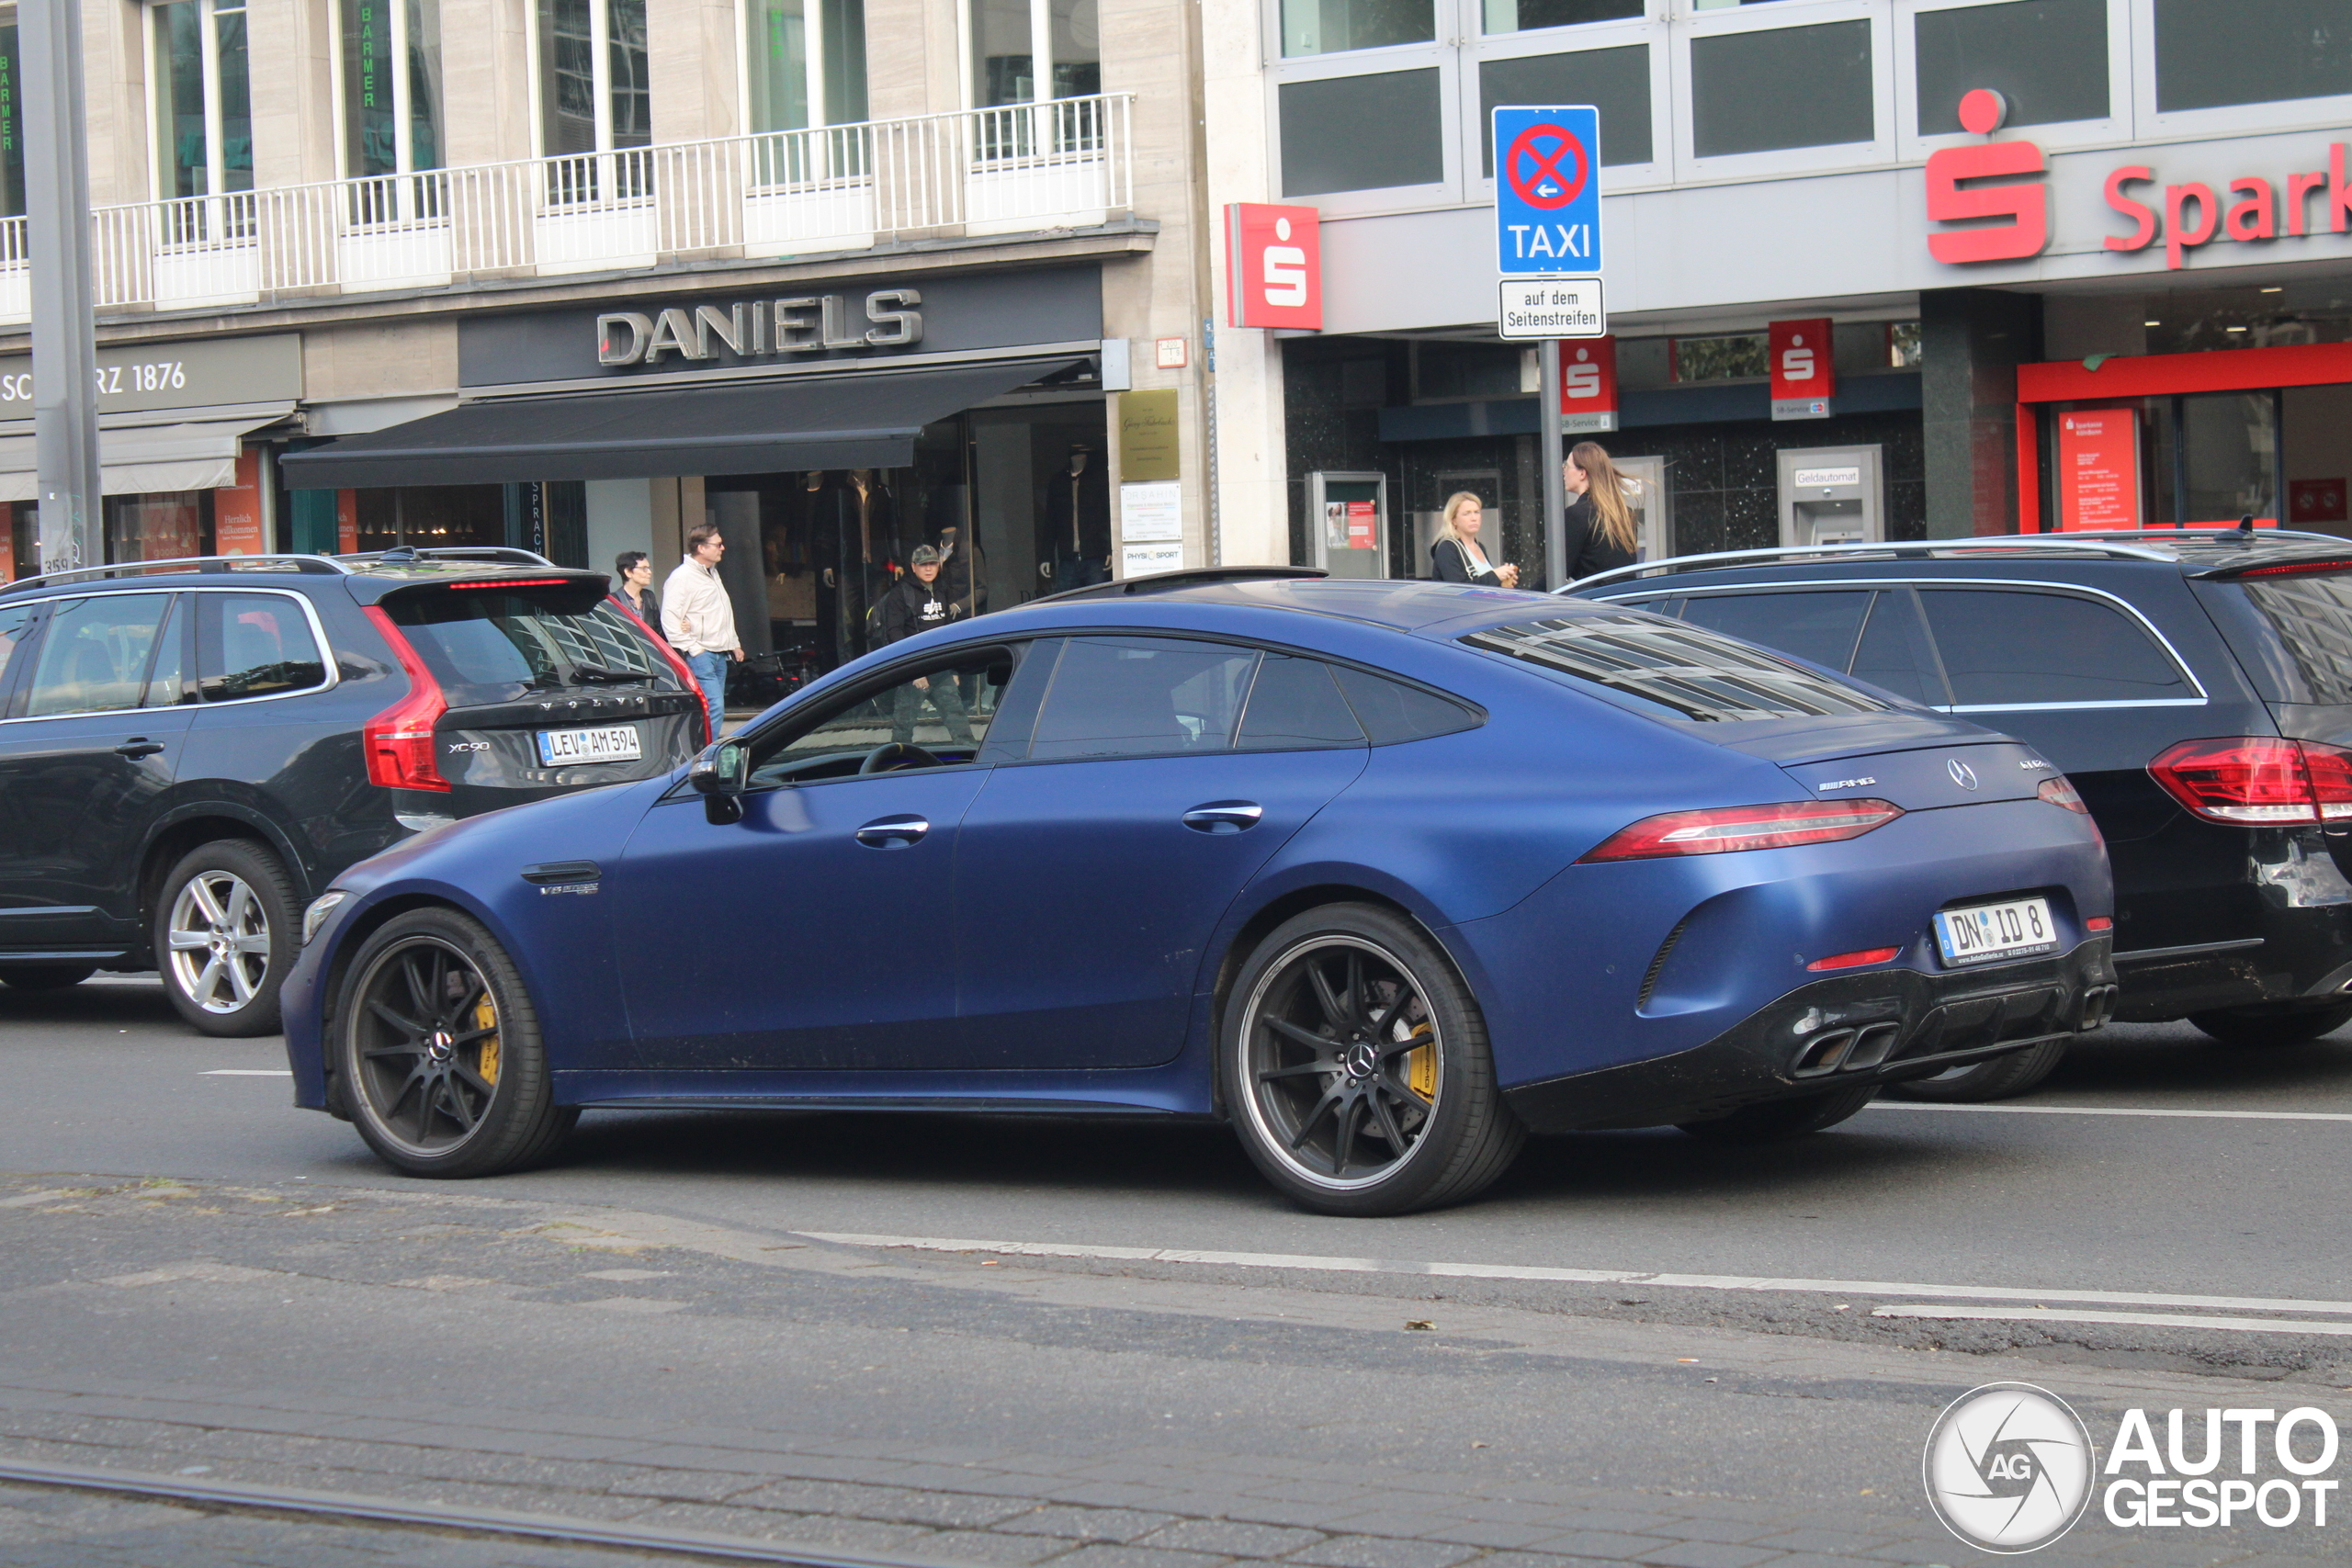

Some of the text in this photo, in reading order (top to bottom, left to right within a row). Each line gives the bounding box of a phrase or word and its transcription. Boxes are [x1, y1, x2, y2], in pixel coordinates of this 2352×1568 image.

[361, 7, 374, 107] BARMER
[0, 56, 12, 150] BARMER
[1508, 223, 1590, 258] TAXI
[1524, 290, 1578, 306] auf dem
[597, 288, 922, 367] DANIELS
[1508, 310, 1597, 327] Seitenstreifen
[2, 361, 186, 401] SCRZ 1876
[1797, 472, 1857, 484] Geldautomat
[224, 513, 252, 524] Herzlich
[218, 525, 258, 535] willkommen
[45, 558, 69, 574] 359
[540, 696, 644, 711] VOLVO
[550, 729, 638, 757] LEV AM 594
[1951, 904, 2043, 951] DN ID 8
